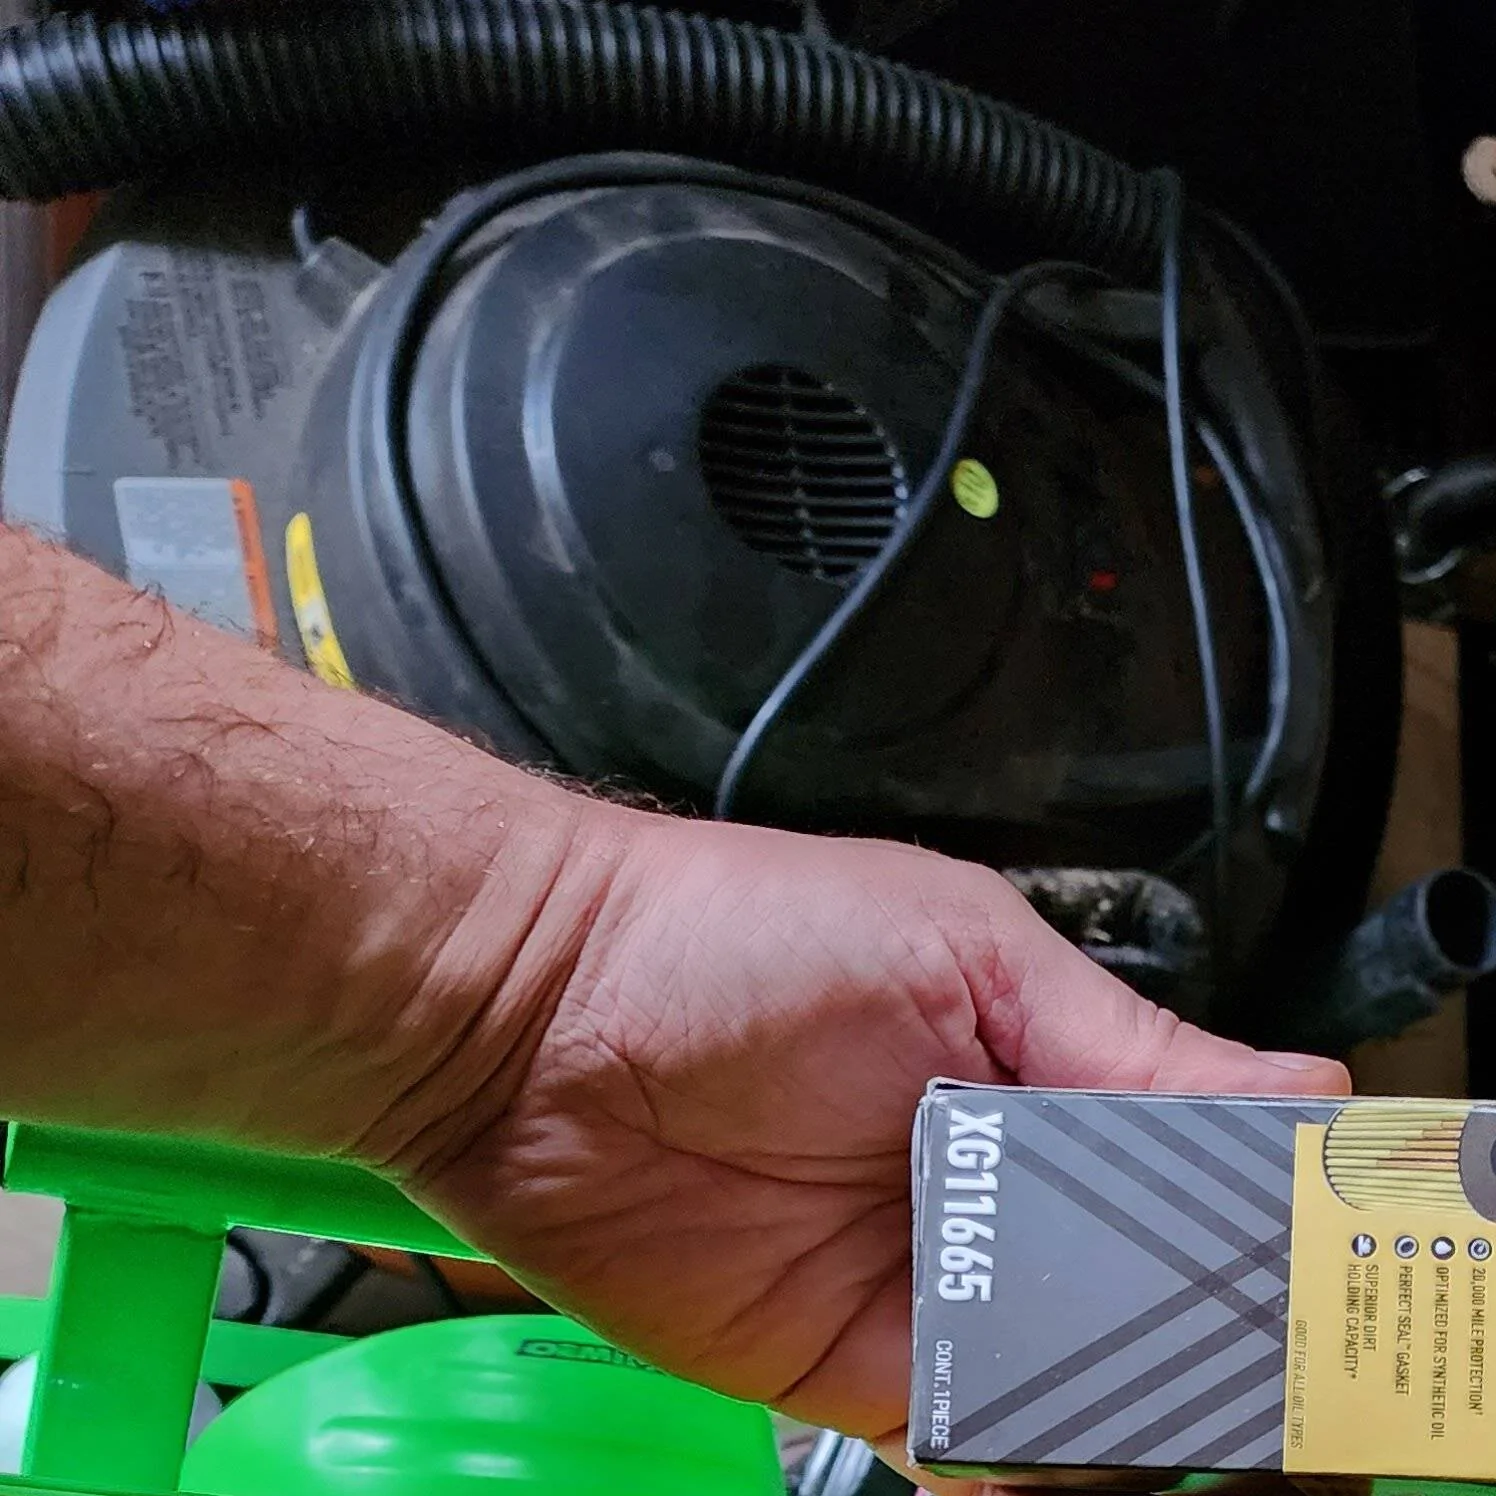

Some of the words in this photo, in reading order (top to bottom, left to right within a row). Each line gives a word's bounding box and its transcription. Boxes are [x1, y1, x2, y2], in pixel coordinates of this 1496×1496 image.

[937, 1108, 1004, 1303] XG11665
[1345, 1263, 1361, 1315] HOLDING
[1363, 1263, 1379, 1322] SUPERIOR
[1397, 1265, 1413, 1314] PERFECT
[1434, 1266, 1450, 1328] OPTIMIZED
[1469, 1267, 1486, 1306] 20,000
[1294, 1319, 1308, 1349] GOOD
[1362, 1325, 1377, 1352] DIRT
[1470, 1308, 1485, 1336] MILE
[1433, 1331, 1448, 1354] FOR
[933, 1339, 954, 1389] CONT.
[1293, 1350, 1307, 1372] FOR
[1395, 1351, 1410, 1397] GASKET
[1293, 1373, 1306, 1394] ALL
[1431, 1356, 1447, 1419] SYNTHETIC
[1292, 1396, 1305, 1412] OIL
[1291, 1416, 1305, 1450] TYPES
[1430, 1422, 1445, 1441] OIL
